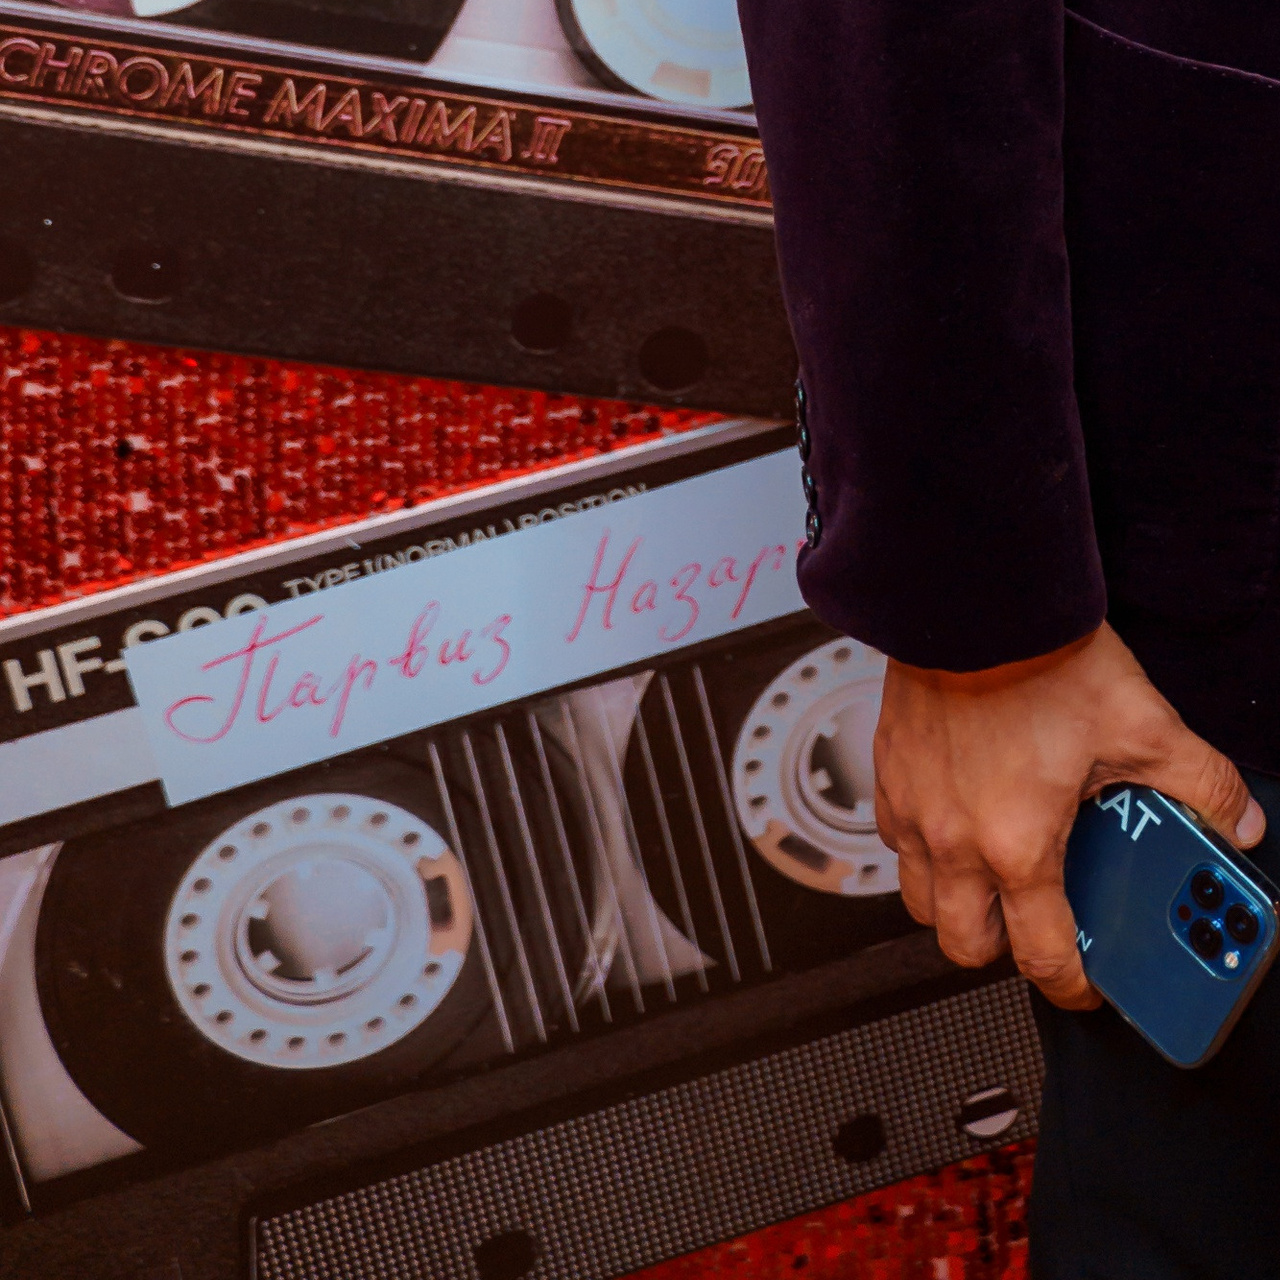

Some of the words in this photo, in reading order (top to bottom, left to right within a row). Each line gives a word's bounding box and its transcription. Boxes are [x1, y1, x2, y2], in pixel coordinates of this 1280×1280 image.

[0, 36, 263, 118] CHROME
[263, 77, 512, 163] MAXIMA
[164, 599, 512, 743] Парвиз
